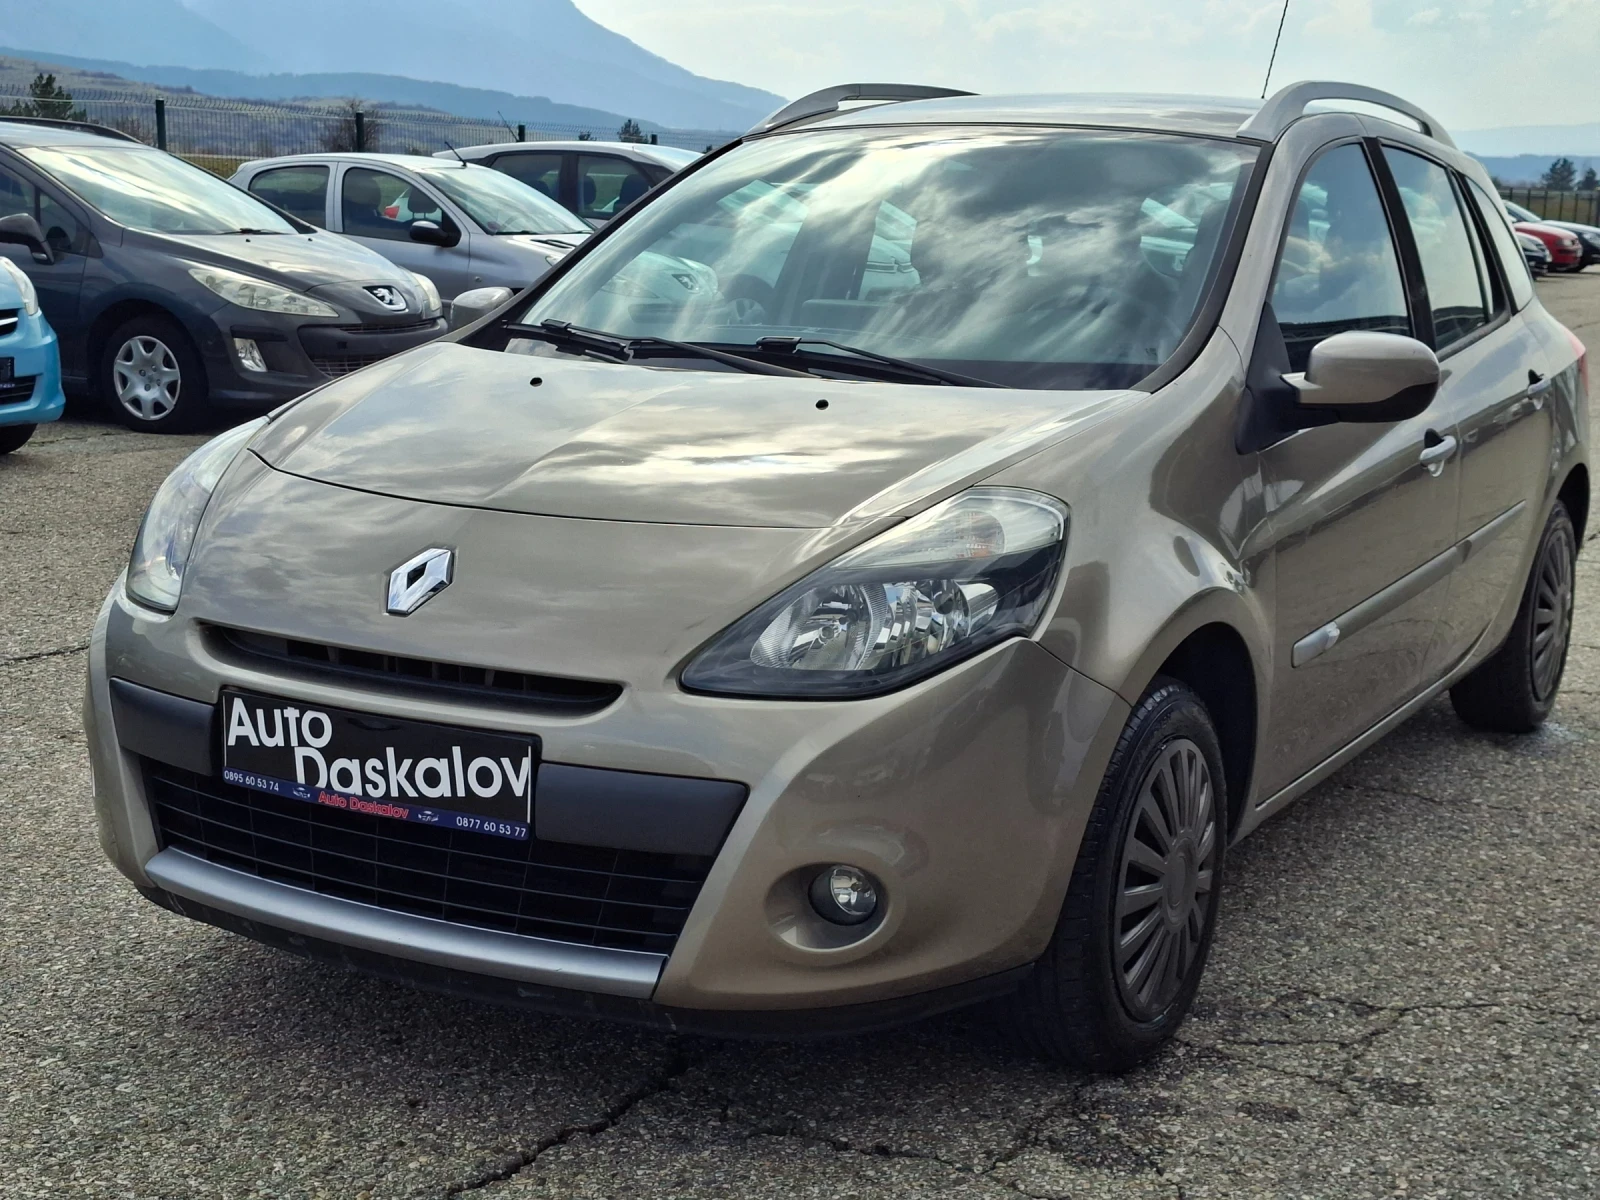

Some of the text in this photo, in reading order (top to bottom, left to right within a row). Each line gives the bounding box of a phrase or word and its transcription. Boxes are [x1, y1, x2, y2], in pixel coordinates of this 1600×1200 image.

[227, 697, 332, 748] Auto
[224, 770, 279, 792] 0895 60 53 74
[294, 745, 529, 798] Daskalov
[318, 791, 409, 819] Auto Daskalov
[456, 816, 527, 837] 0877 60 53 77
